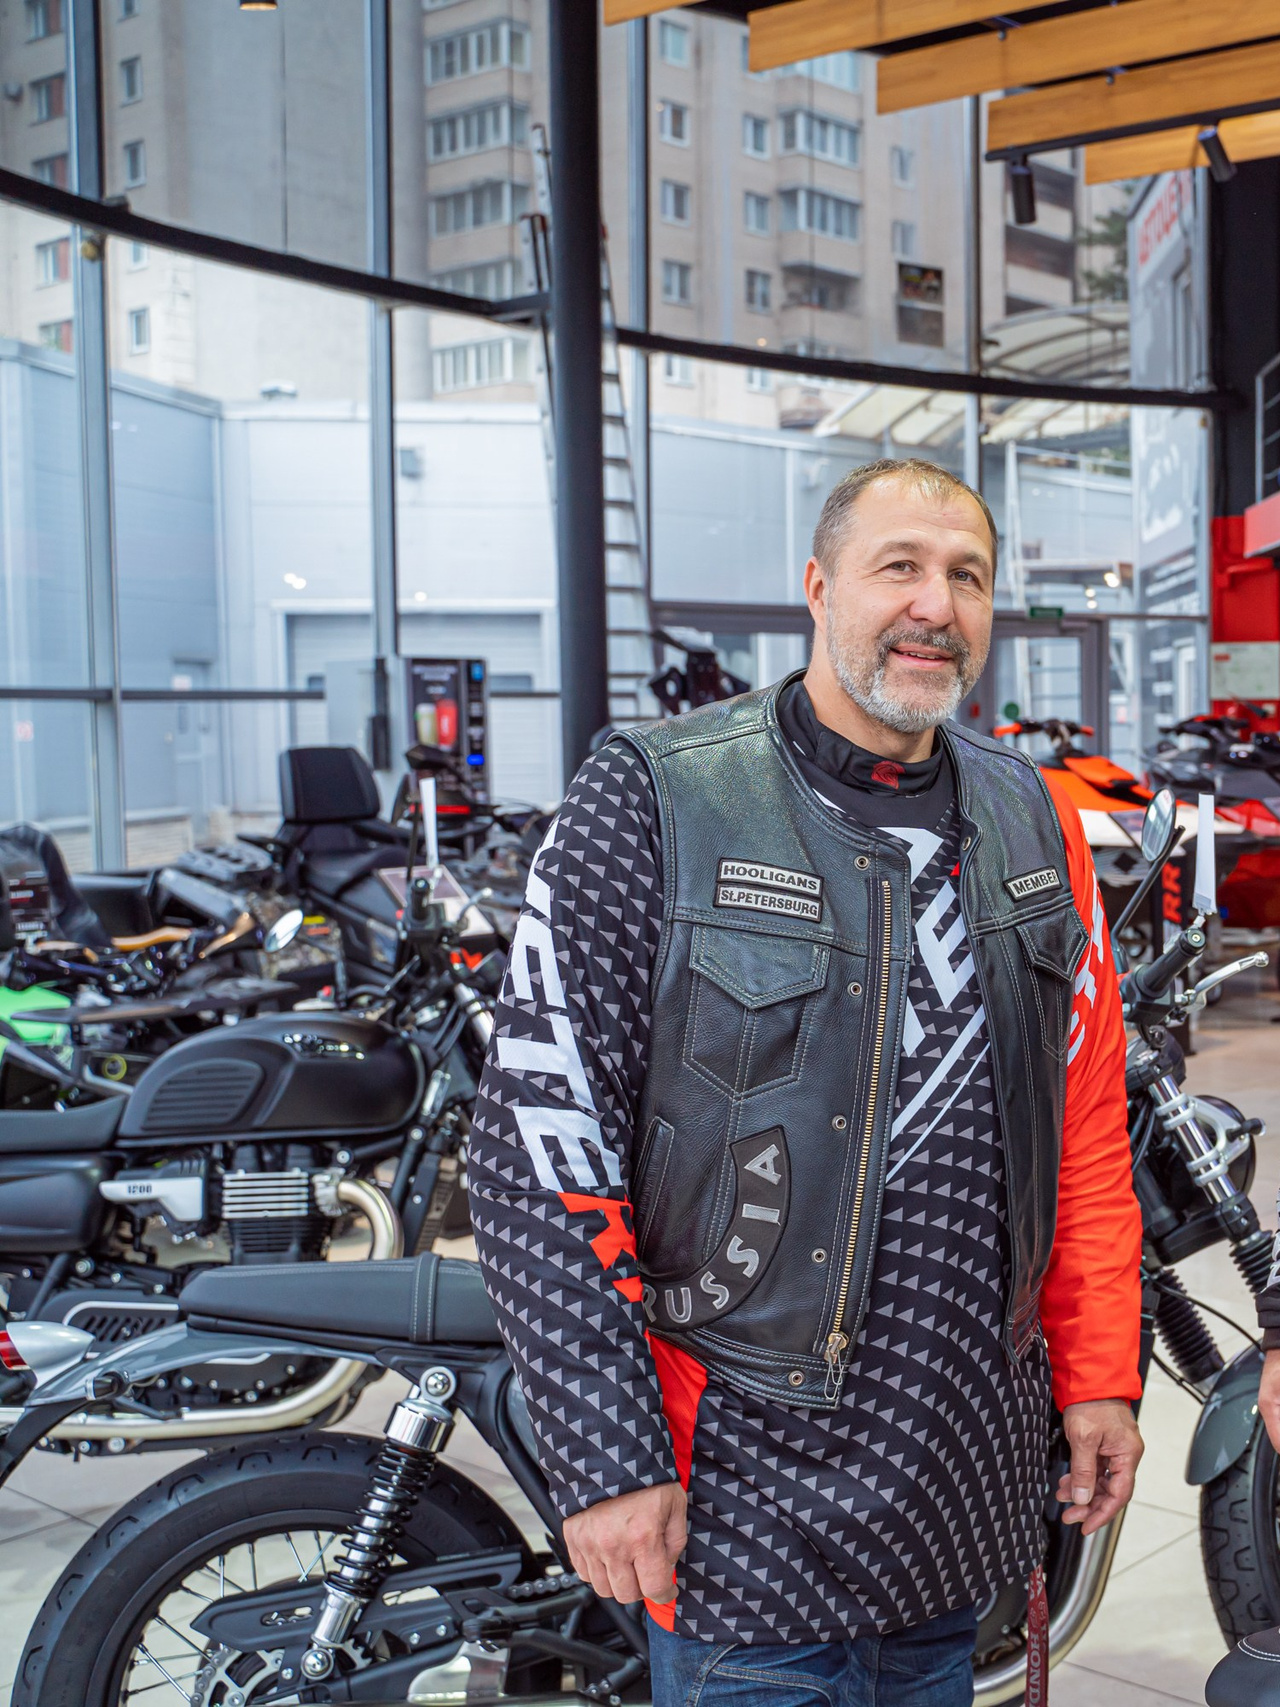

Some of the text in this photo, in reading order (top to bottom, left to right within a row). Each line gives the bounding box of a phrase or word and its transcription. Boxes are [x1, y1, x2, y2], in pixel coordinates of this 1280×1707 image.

[723, 864, 818, 891] HOOLIGANS
[1012, 870, 1059, 896] MEMBER
[720, 889, 819, 917] St.PETERSBURG
[127, 1184, 153, 1194] 1200
[1028, 1631, 1041, 1707] HOND
